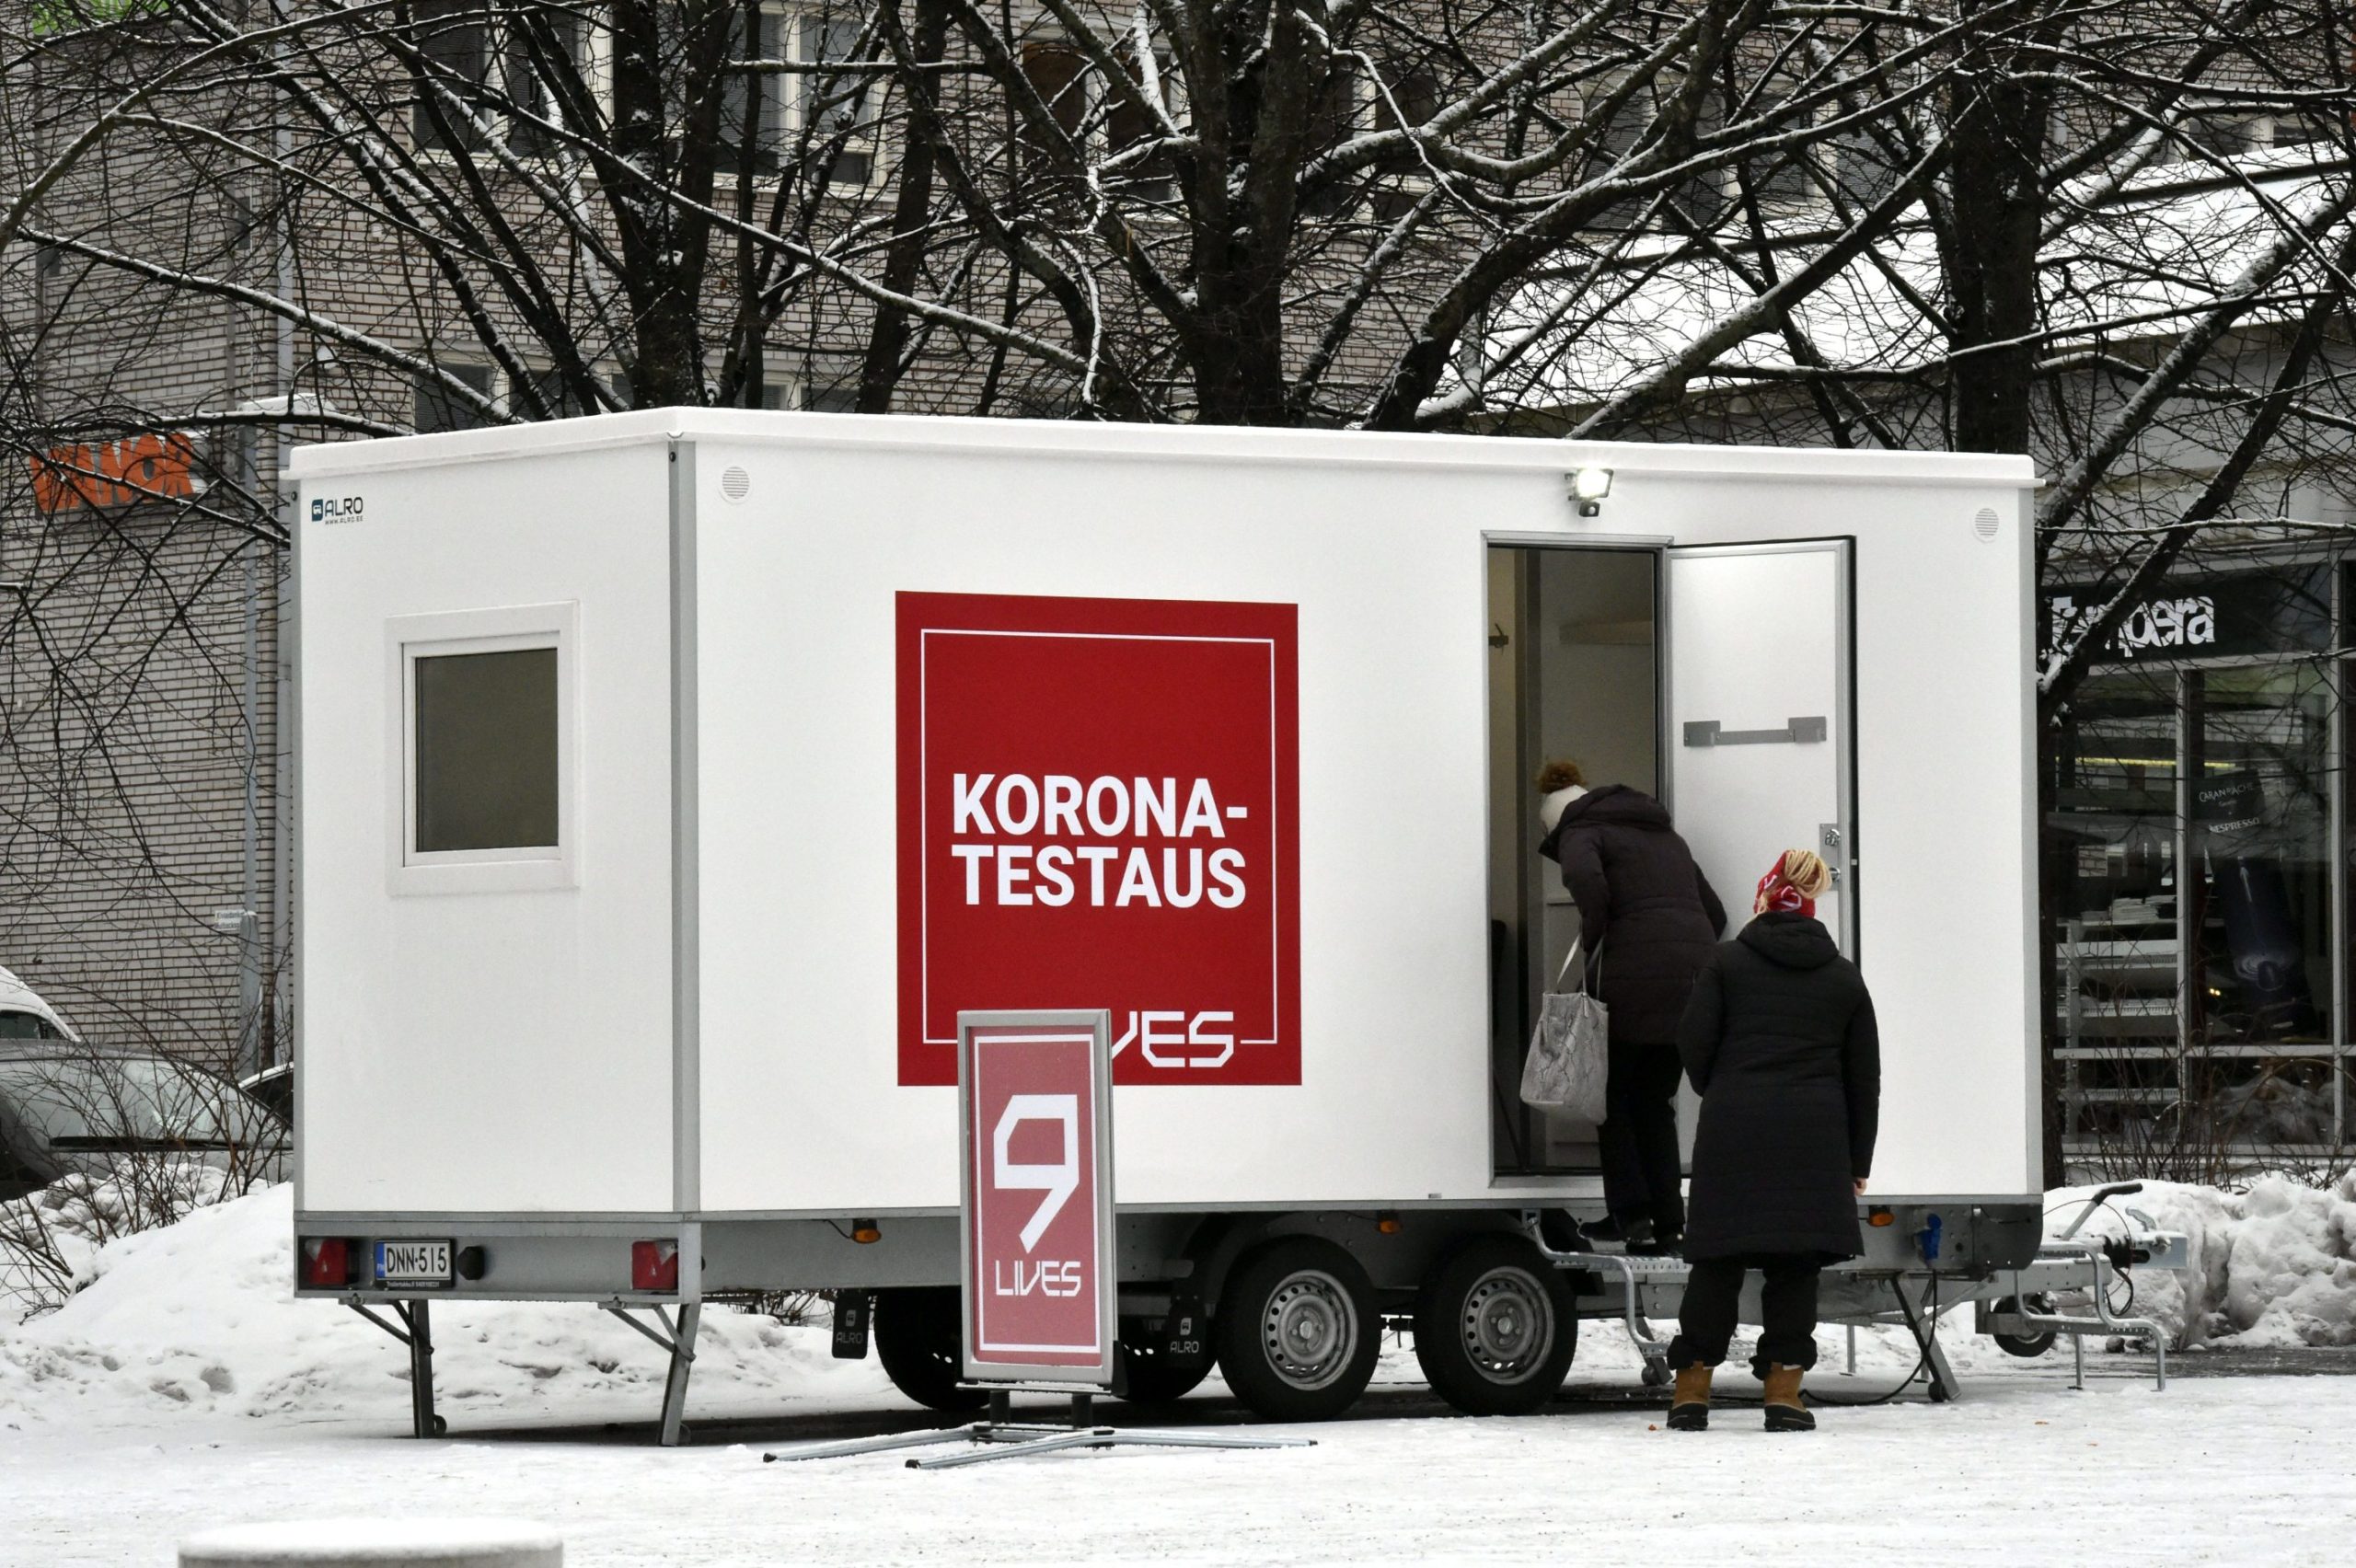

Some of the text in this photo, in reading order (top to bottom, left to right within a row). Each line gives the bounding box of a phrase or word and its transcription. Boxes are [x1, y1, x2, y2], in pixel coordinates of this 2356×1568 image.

[325, 497, 364, 516] ALRO
[2050, 596, 2215, 658] Tepera
[953, 773, 1248, 838] KORONA-
[952, 844, 1247, 909] TESTAUS
[994, 1094, 1080, 1254] 9
[387, 1247, 447, 1274] DNN-515
[995, 1260, 1081, 1297] LIVES
[836, 1332, 863, 1343] ALRO
[1170, 1341, 1200, 1354] ALRO
